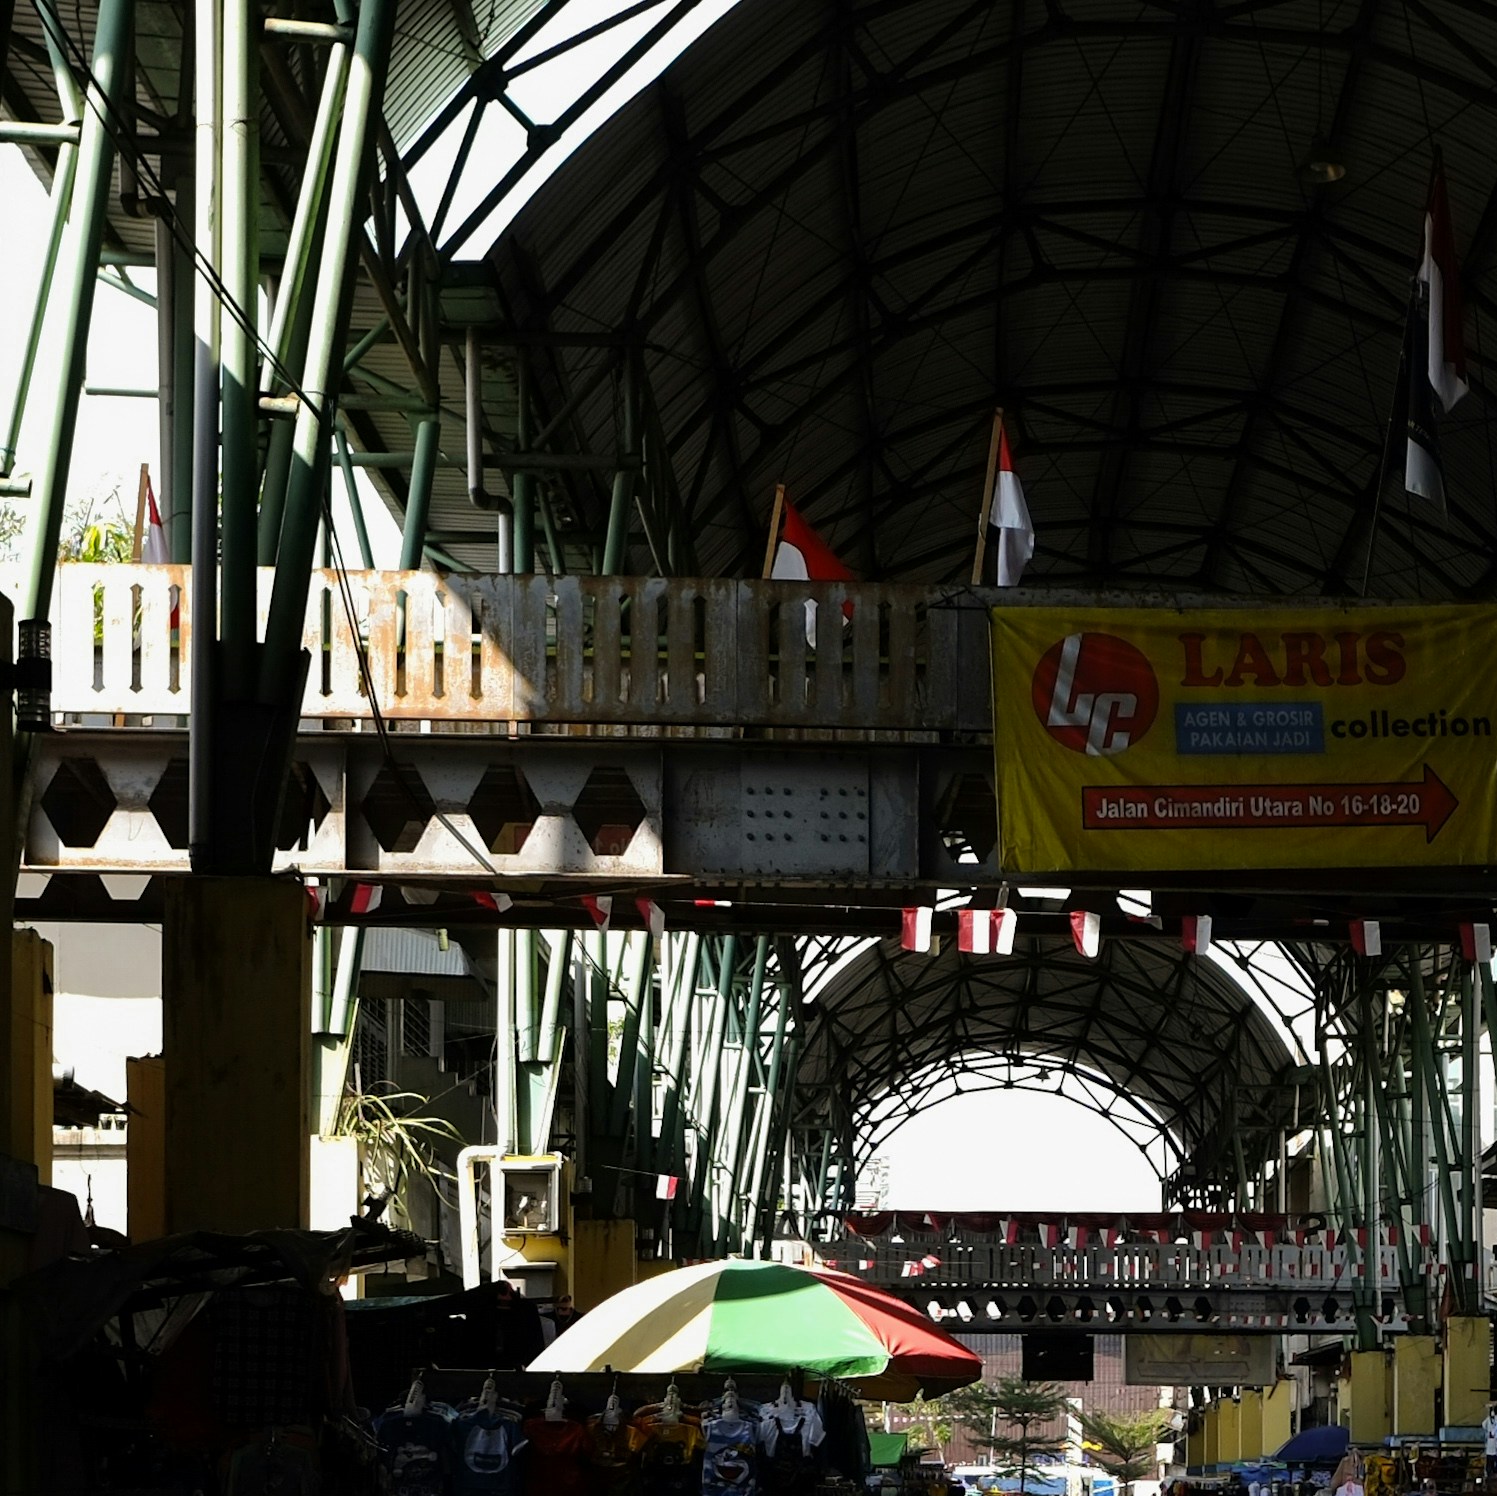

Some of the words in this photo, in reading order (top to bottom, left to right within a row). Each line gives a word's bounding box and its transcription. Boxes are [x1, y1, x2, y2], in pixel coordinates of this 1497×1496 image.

[1179, 631, 1407, 688] LARIS
[1183, 711, 1231, 729] AGEN
[1236, 711, 1248, 727] &
[1252, 709, 1315, 728] GROSIR
[1331, 708, 1492, 740] collection
[1190, 731, 1269, 748] PAKAIAN
[1272, 730, 1312, 747] JADI
[1096, 797, 1149, 820] Jalan
[1154, 796, 1245, 819] Cimandiri
[1250, 796, 1303, 818] Utara
[1308, 795, 1335, 816] No
[1340, 793, 1421, 816] 16-18-20
